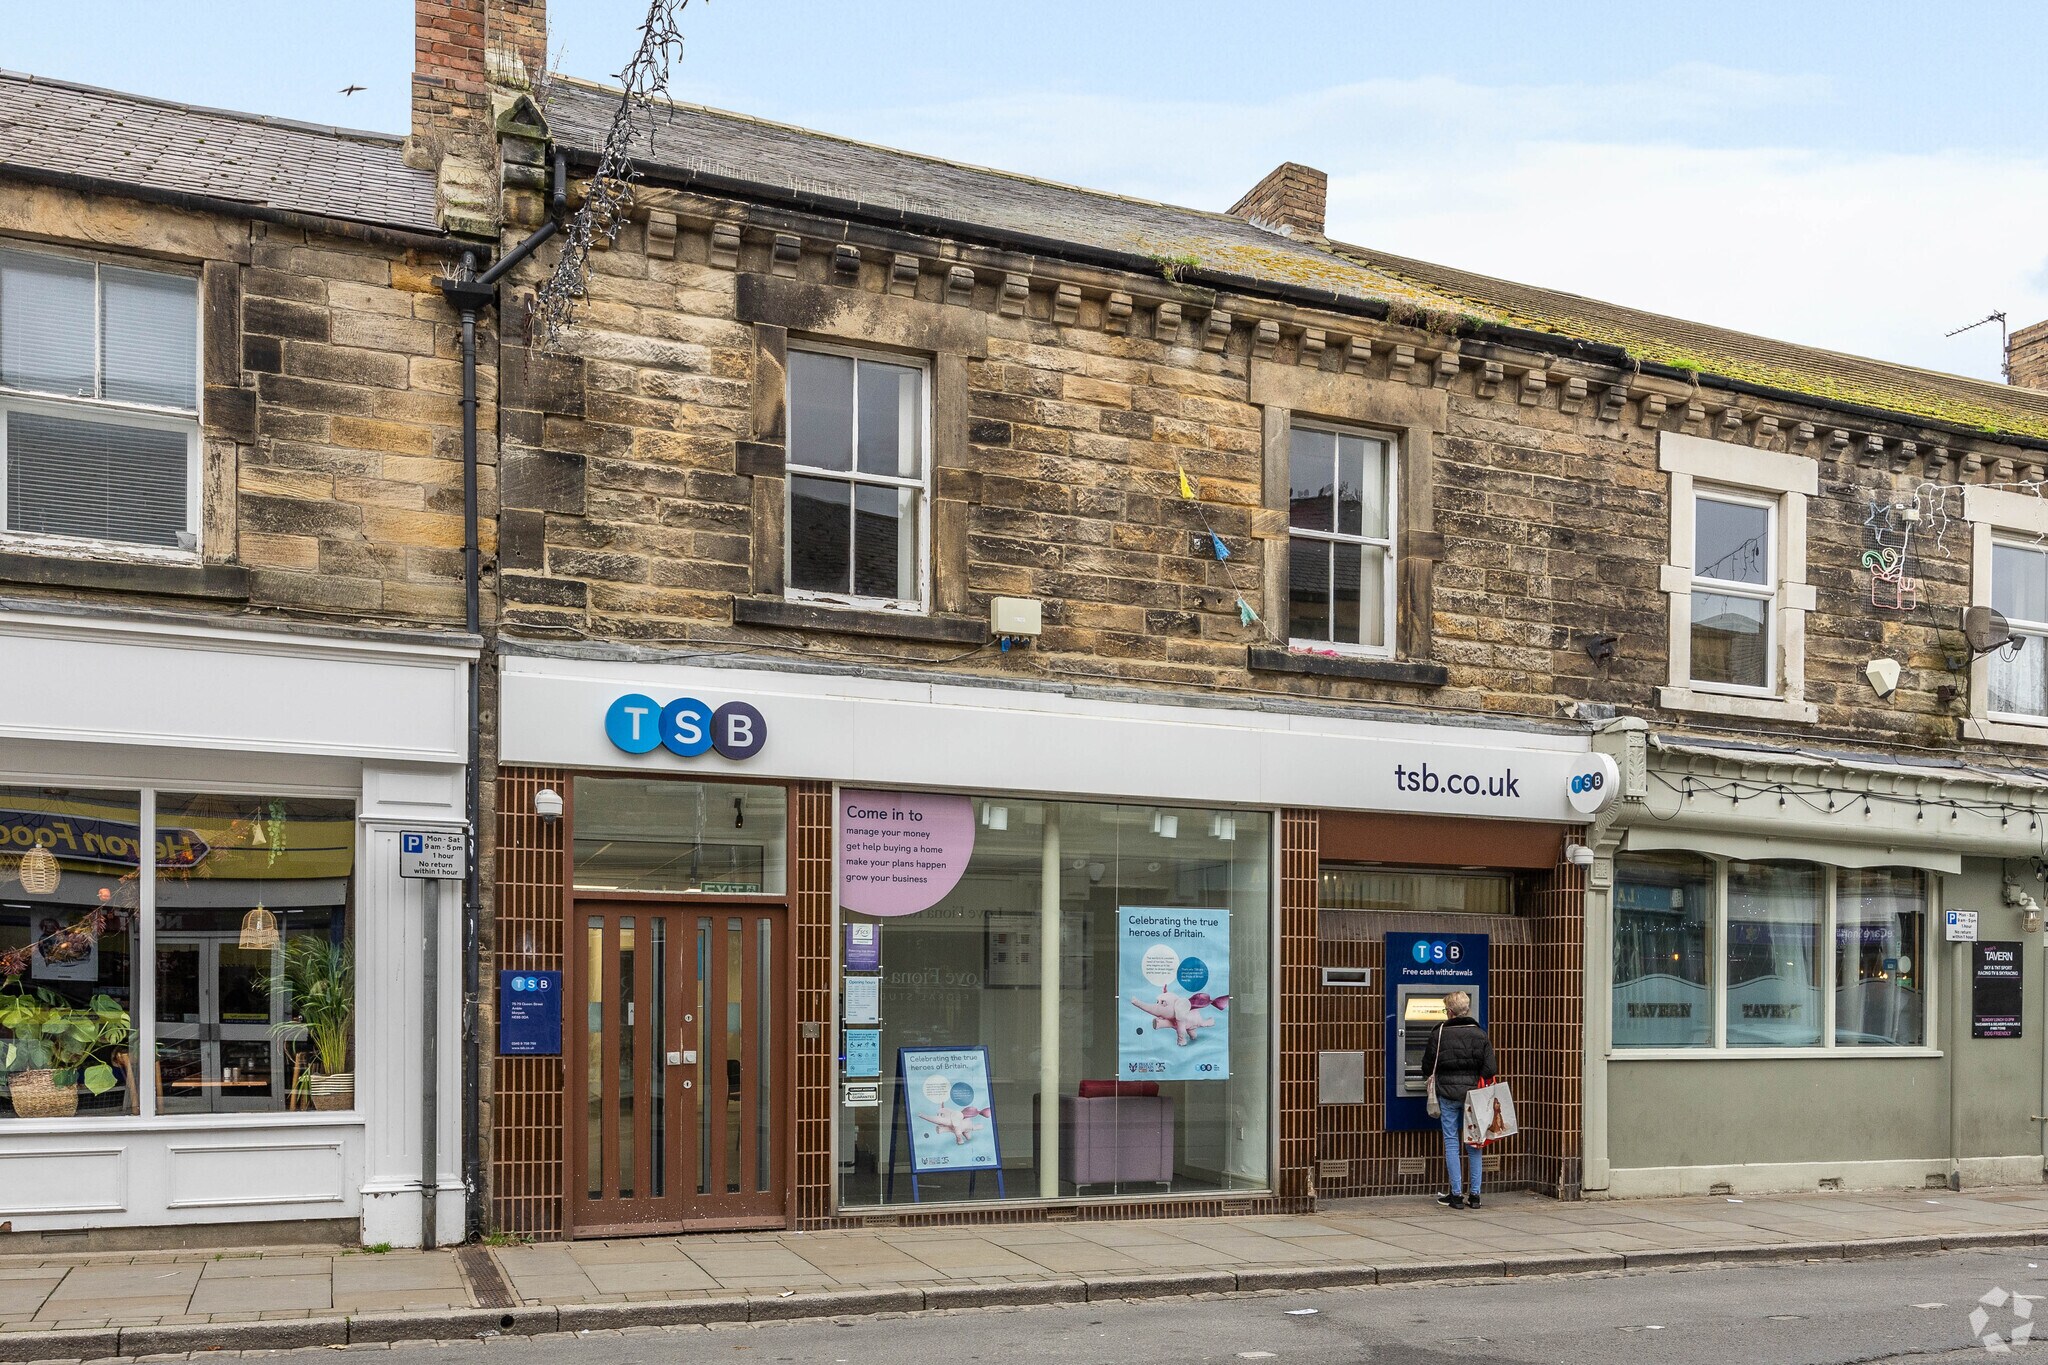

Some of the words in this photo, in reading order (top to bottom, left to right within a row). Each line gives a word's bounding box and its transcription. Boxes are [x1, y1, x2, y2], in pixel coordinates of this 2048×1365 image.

[623, 705, 755, 748] TSB
[1395, 763, 1520, 798] tsb.co.uk
[1574, 774, 1602, 790] TSB
[847, 805, 887, 820] Come
[892, 808, 904, 820] in
[909, 809, 923, 821] to
[846, 828, 879, 838] manage
[881, 830, 901, 838] your
[903, 830, 930, 840] money
[408, 837, 420, 851] P
[427, 835, 442, 843] Mon
[846, 843, 860, 852] get
[863, 842, 881, 852] help
[883, 844, 912, 854] buying
[920, 845, 943, 854] home
[846, 858, 868, 866] make
[870, 860, 890, 868] your
[892, 859, 914, 869] plans
[916, 860, 947, 871] happen
[846, 875, 868, 883] grow
[870, 875, 890, 883] your
[892, 874, 928, 883] business
[704, 884, 743, 893] EXIT
[1129, 915, 1181, 927] Celebrating
[1184, 917, 1197, 926] the
[1200, 918, 1218, 926] true
[1949, 913, 1956, 924] P
[1129, 928, 1160, 937] heroes
[1162, 928, 1172, 937] of
[1174, 929, 1206, 938] Britain.
[1418, 945, 1460, 959] TSB
[1985, 951, 2013, 961] TAVERN
[515, 980, 549, 989] TSB
[1628, 1003, 1692, 1018] TAVERN
[910, 1055, 950, 1063] Celebrating
